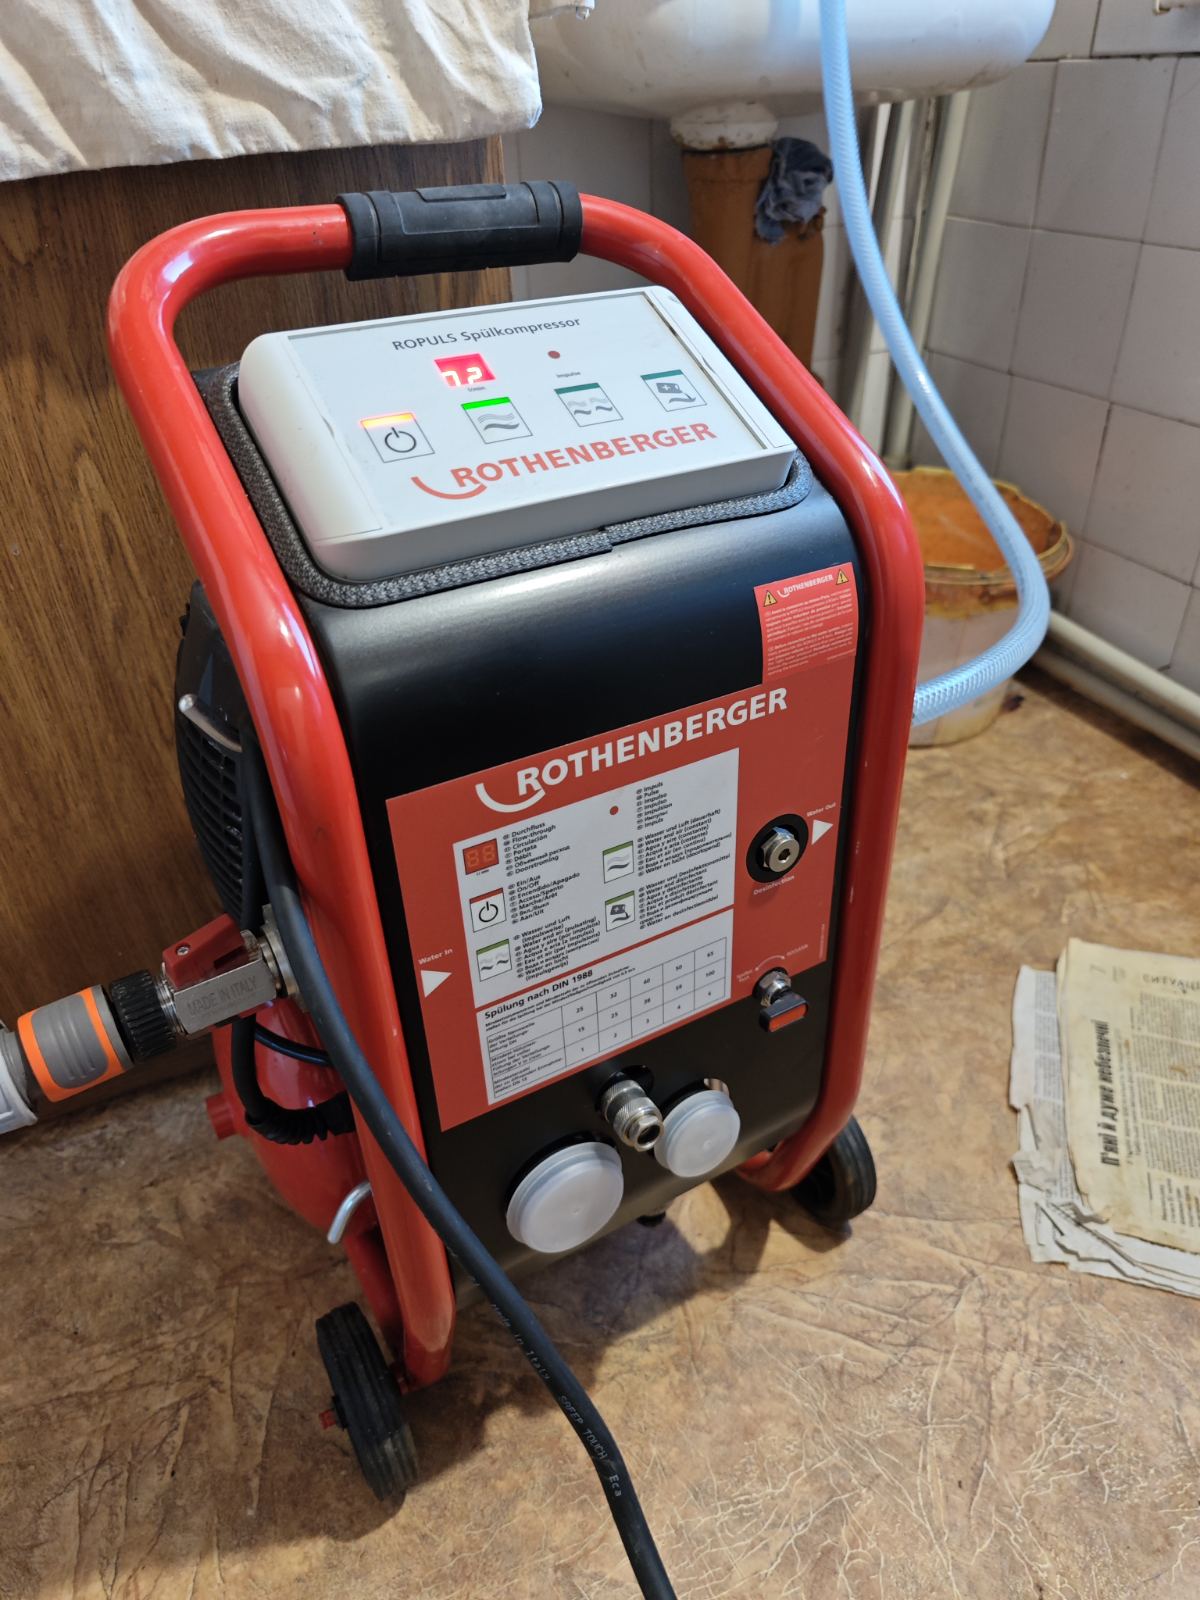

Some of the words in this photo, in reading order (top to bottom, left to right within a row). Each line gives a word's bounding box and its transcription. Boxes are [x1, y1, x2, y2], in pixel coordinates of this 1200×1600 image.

[392, 333, 457, 350] ROPULS
[461, 318, 581, 342] Spülkompressor
[450, 422, 717, 489] ROTHENBERGER
[784, 574, 834, 595] ROTHENBERGER
[517, 687, 788, 796] ROTHENBERGER
[512, 823, 545, 837] Durchfluss
[512, 825, 556, 843] Flow-through
[513, 835, 547, 849] Circulación
[645, 837, 662, 845] Water
[513, 845, 537, 855] Portata
[517, 876, 541, 886] Ein/Aus
[517, 881, 539, 892] On/Off
[522, 927, 543, 937] Wasser
[523, 939, 540, 948] Water
[523, 946, 539, 954] Agua
[418, 953, 442, 965] Water
[188, 992, 215, 1016] MADE
[220, 988, 230, 1003] IN
[232, 976, 257, 1000] ITALY
[485, 999, 524, 1019] Spülung
[528, 988, 549, 1002] nach
[553, 980, 569, 992] DIN
[572, 970, 592, 984] 1988
[583, 1429, 608, 1460] TOUCH
